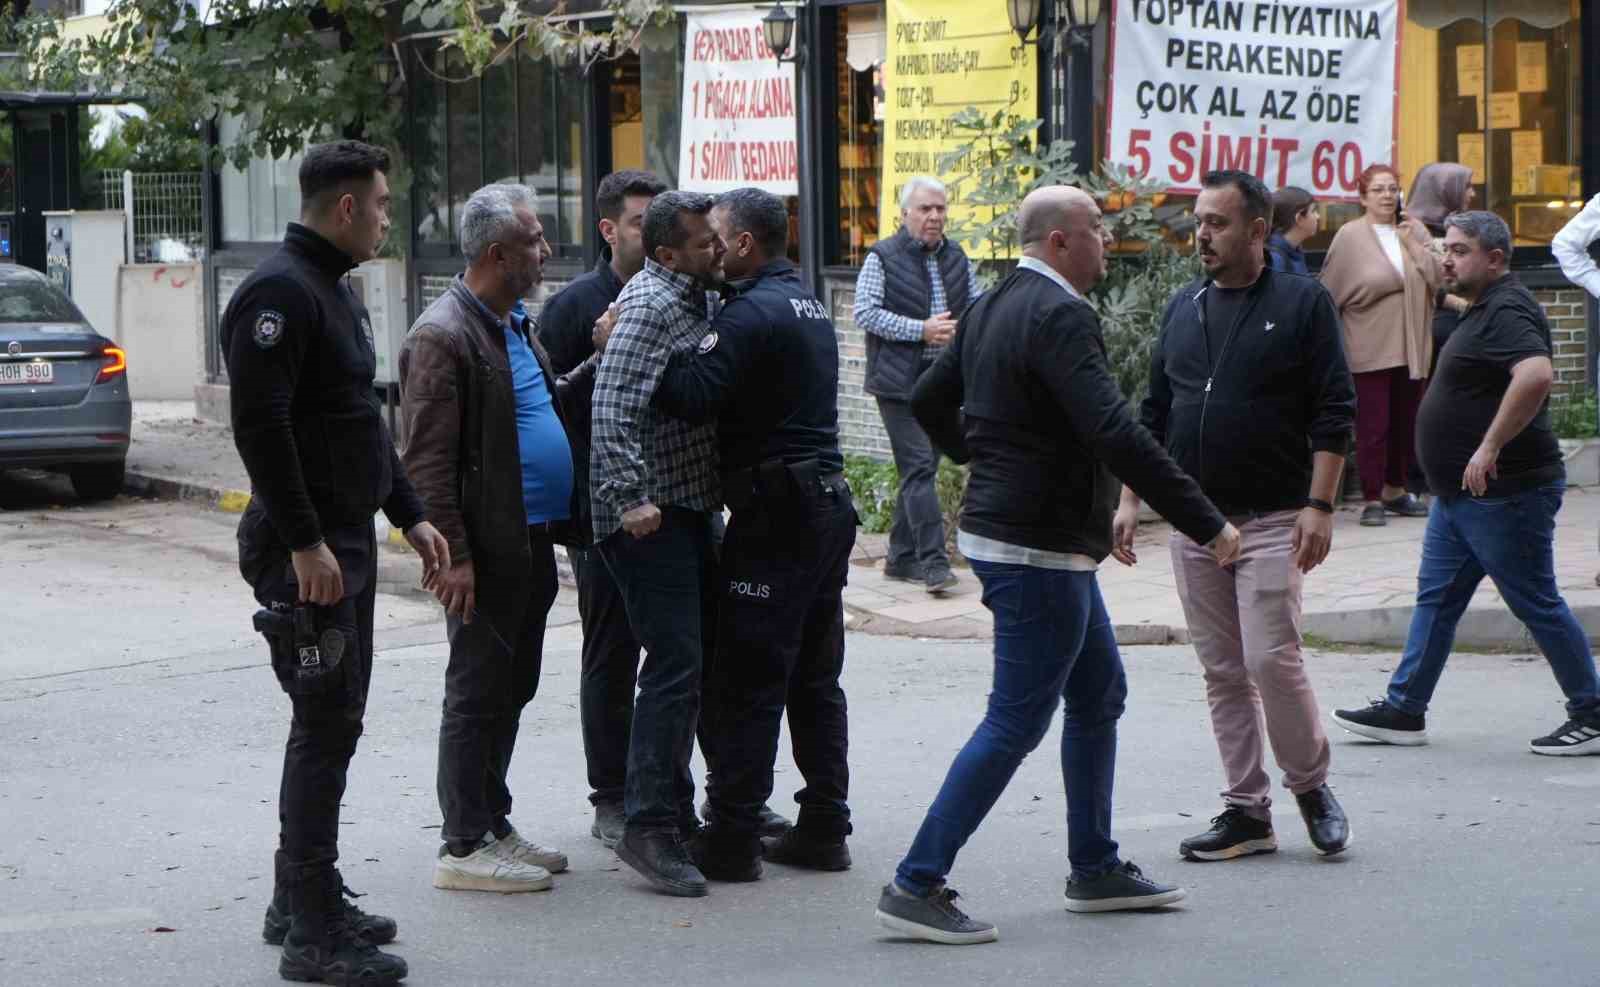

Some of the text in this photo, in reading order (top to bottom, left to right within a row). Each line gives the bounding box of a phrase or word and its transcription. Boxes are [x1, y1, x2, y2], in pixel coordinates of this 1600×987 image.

[1131, 0, 1382, 40] TOPTAN FİYATINA
[715, 28, 753, 62] PAZAR
[1166, 37, 1343, 79] PERAKENDE
[692, 80, 700, 118] 1
[748, 77, 794, 119] ALANA
[1136, 80, 1361, 124] ÇOK AL AZ ÖDE
[689, 142, 696, 180] 1
[740, 140, 800, 181] BEDAVA
[1127, 120, 1363, 192] 5 SİMİT 60
[26, 364, 49, 377] 980
